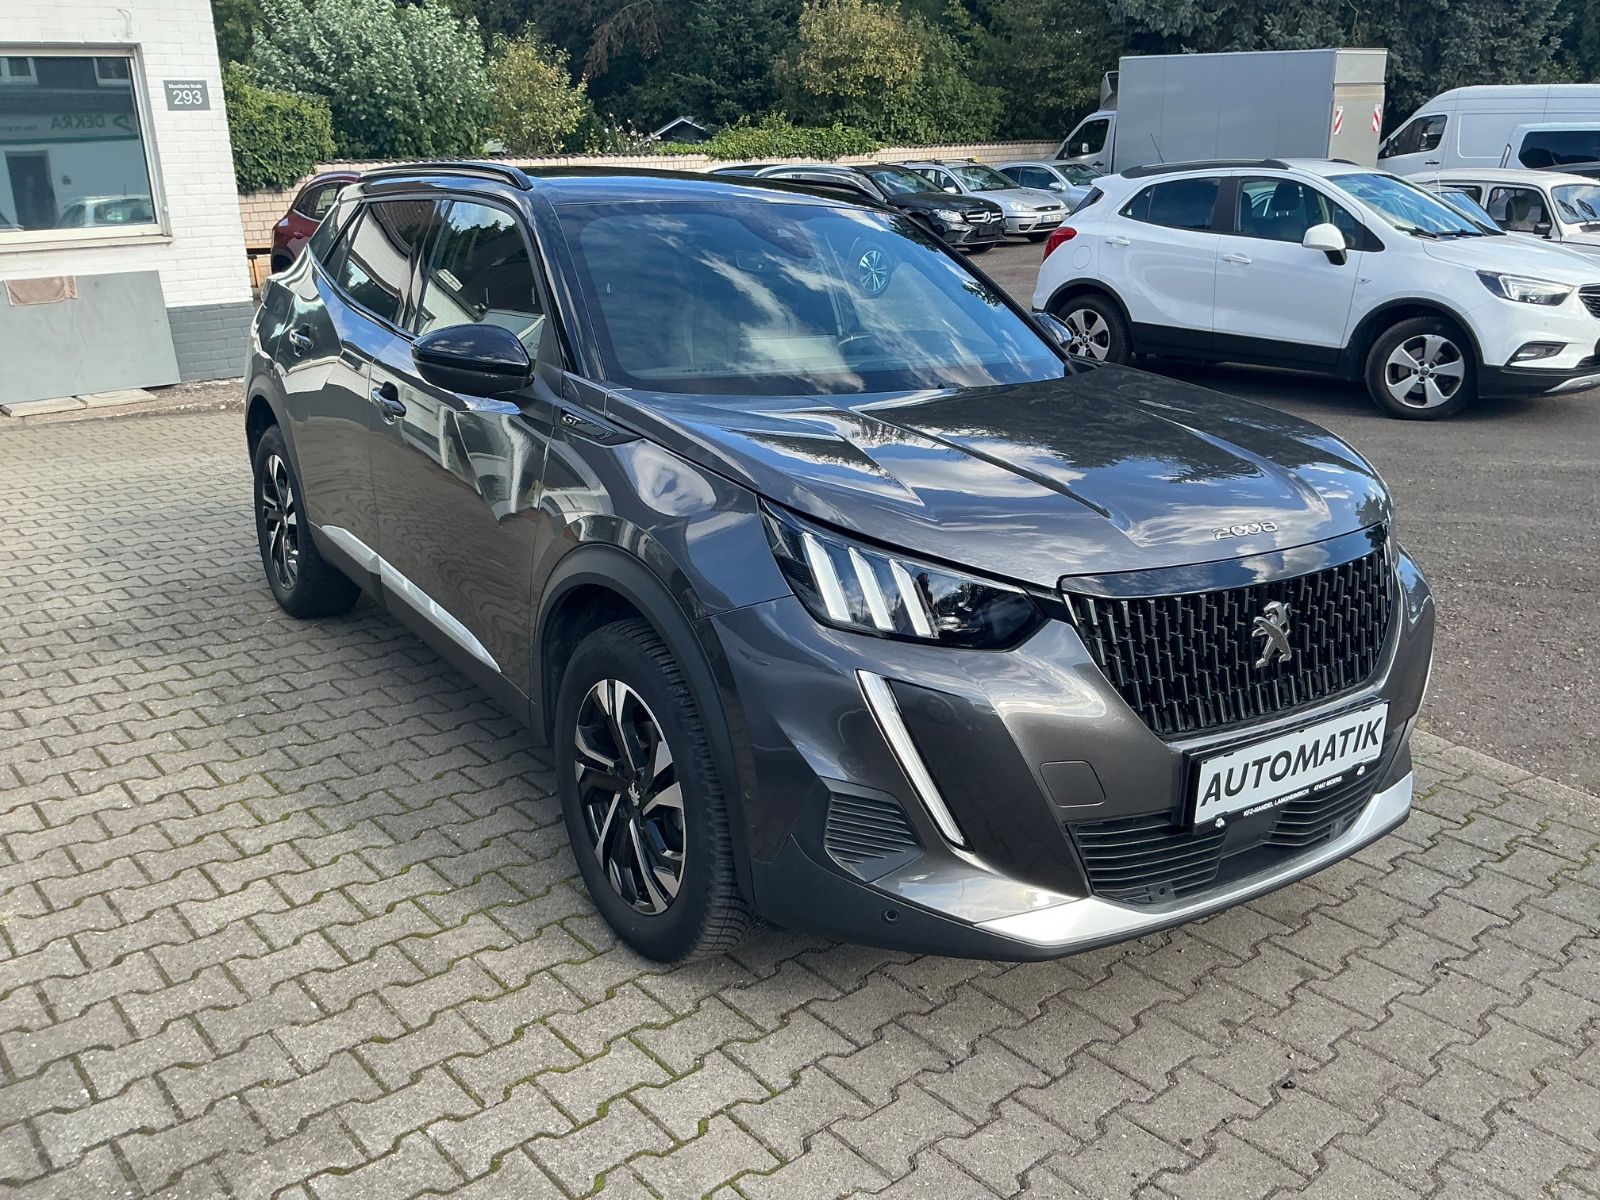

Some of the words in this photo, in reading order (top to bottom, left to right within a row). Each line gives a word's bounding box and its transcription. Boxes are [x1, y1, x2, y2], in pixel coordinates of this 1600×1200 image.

[172, 90, 202, 105] 293
[1212, 521, 1278, 540] 2008
[1199, 717, 1383, 808] AUTOMATIK
